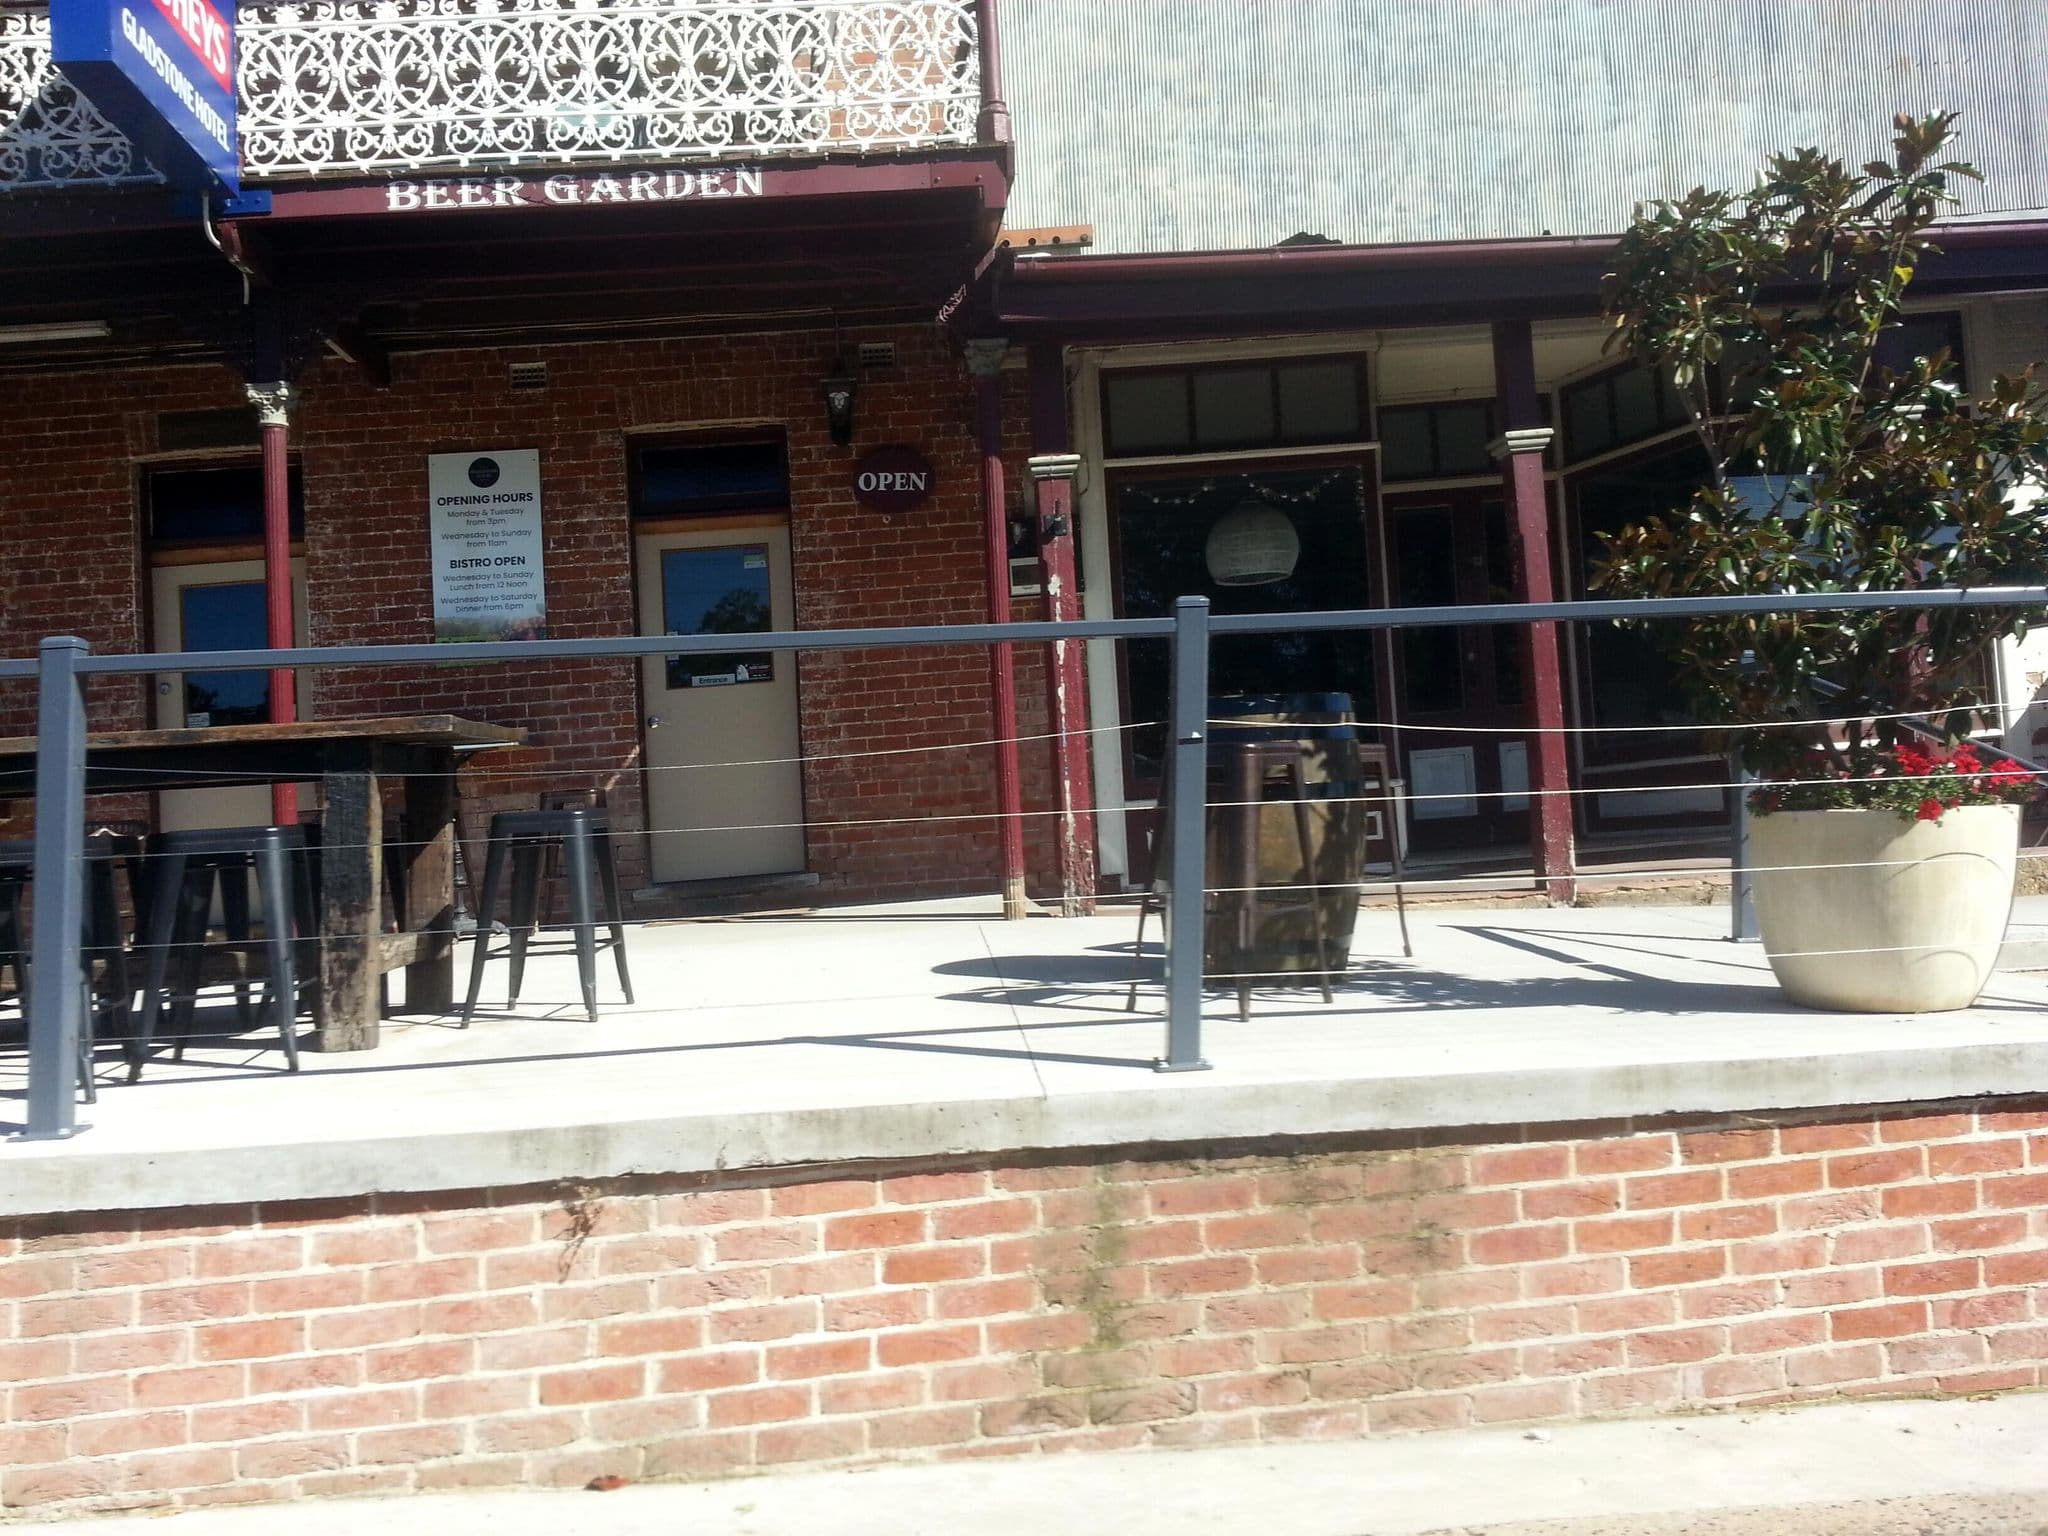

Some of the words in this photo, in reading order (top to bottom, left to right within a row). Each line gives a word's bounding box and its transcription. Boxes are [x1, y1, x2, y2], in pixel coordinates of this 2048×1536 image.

[122, 7, 195, 112] GLADSTONE
[194, 92, 230, 152] HOTEL
[385, 177, 531, 212] BEER
[544, 166, 763, 204] GARDEN
[858, 472, 928, 491] OPEN
[437, 494, 490, 506] OPENING
[492, 492, 534, 503] HOURS
[447, 509, 480, 518] Monday
[490, 507, 525, 516] Tuesday
[441, 531, 489, 540] Wednesday
[491, 530, 499, 538] to
[501, 528, 533, 537] Sunday
[488, 539, 508, 547] 11am
[450, 558, 491, 569] BISTRO
[494, 556, 526, 567] OPEN
[443, 573, 491, 582] Wednesday
[503, 570, 534, 579] Sunday
[449, 583, 474, 591] Lunch
[506, 580, 528, 588] Noon
[441, 595, 489, 604] Wednesday
[500, 593, 538, 601] Saturday
[455, 604, 481, 613] Dinner
[698, 674, 729, 685] Entrance
